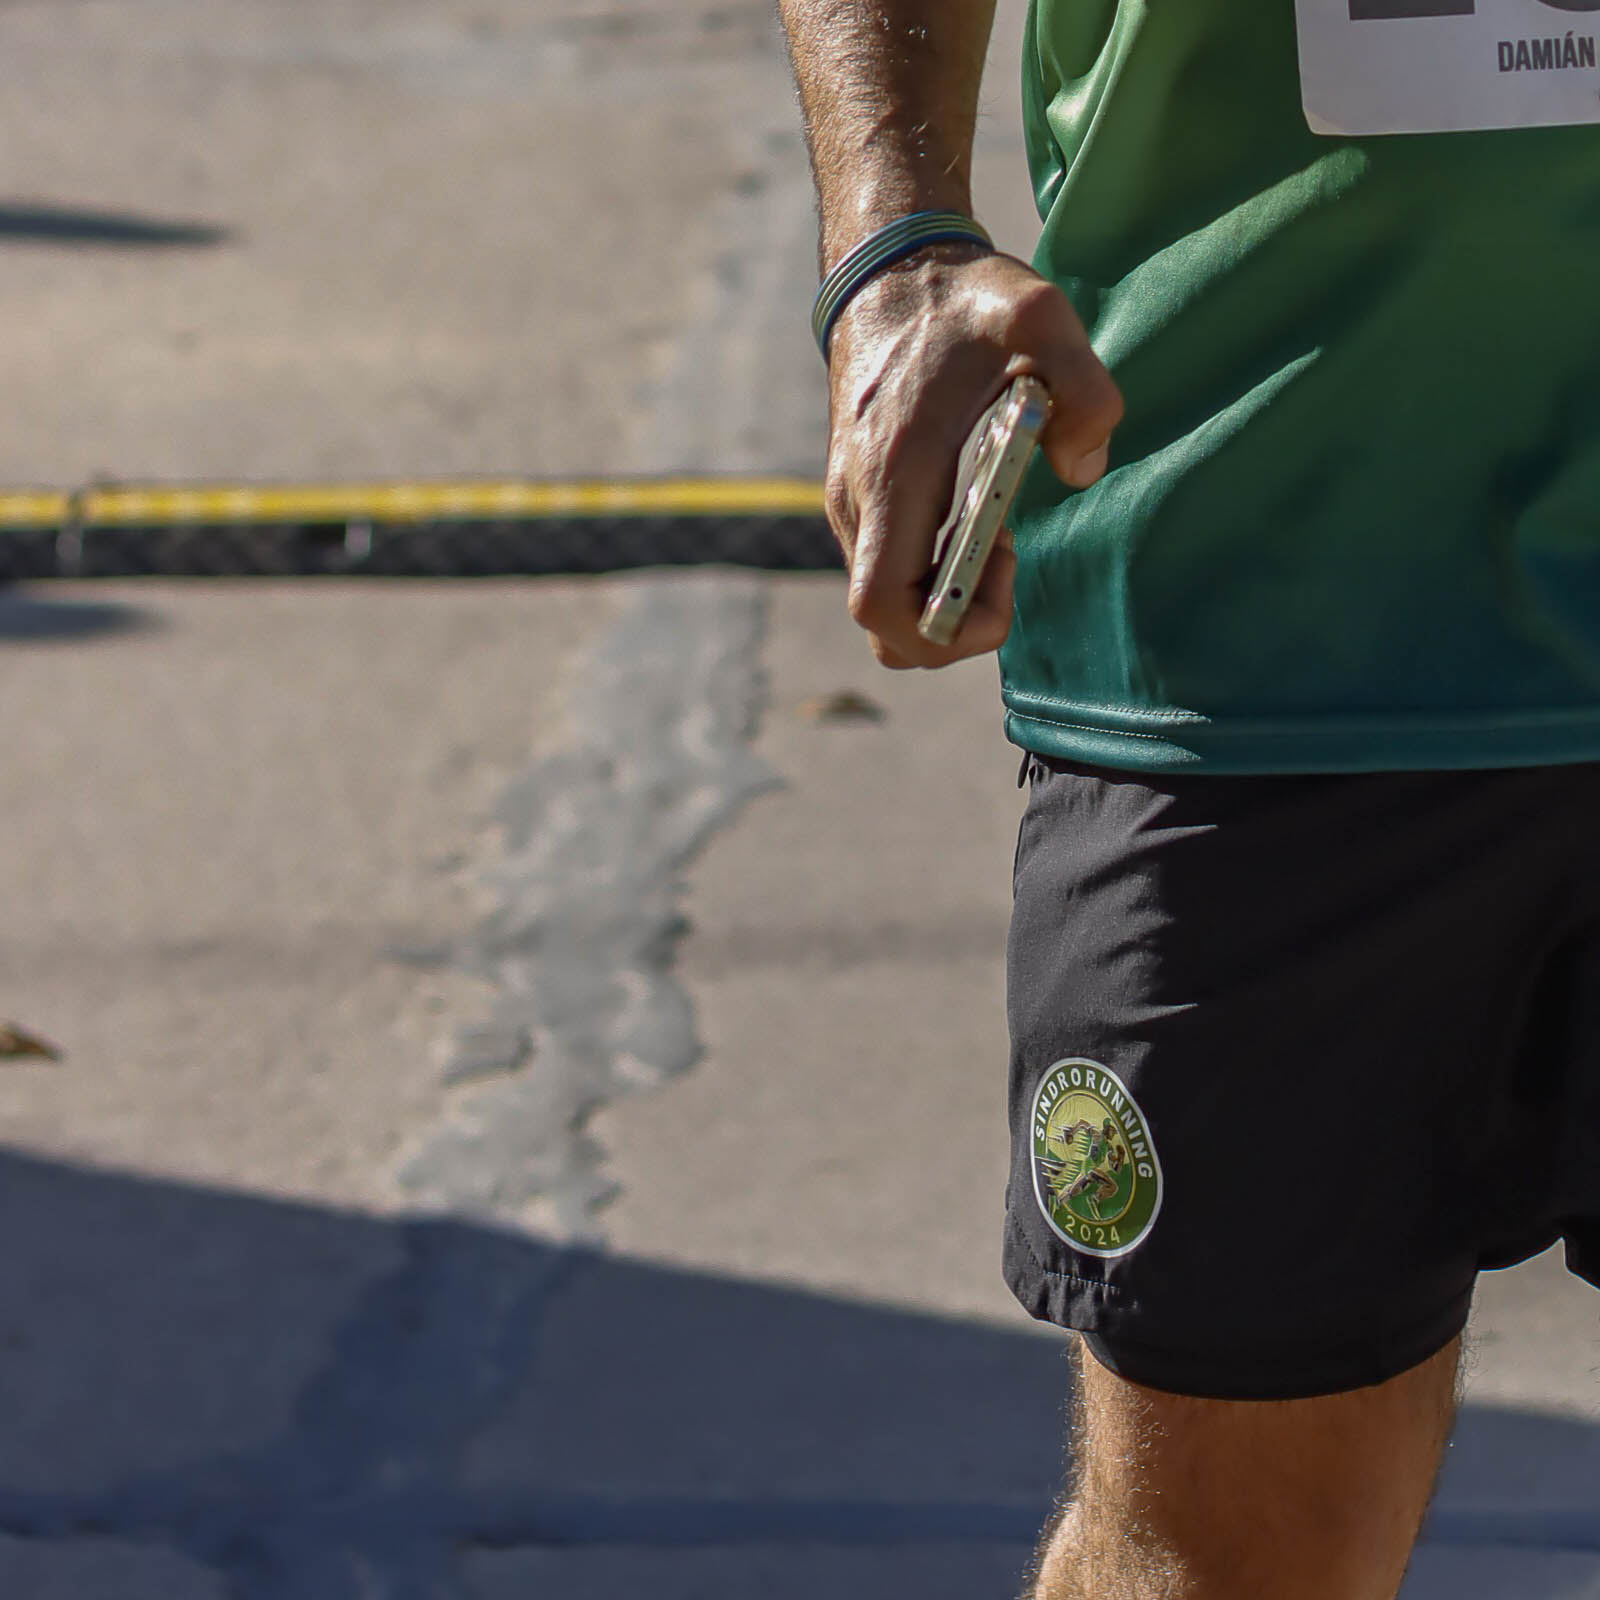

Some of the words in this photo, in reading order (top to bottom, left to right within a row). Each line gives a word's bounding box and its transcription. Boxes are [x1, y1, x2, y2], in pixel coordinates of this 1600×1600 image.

[1497, 30, 1596, 73] DAMIÁN
[1035, 1067, 1153, 1178] SINDRORUNNING
[1064, 1215, 1121, 1246] 2024
